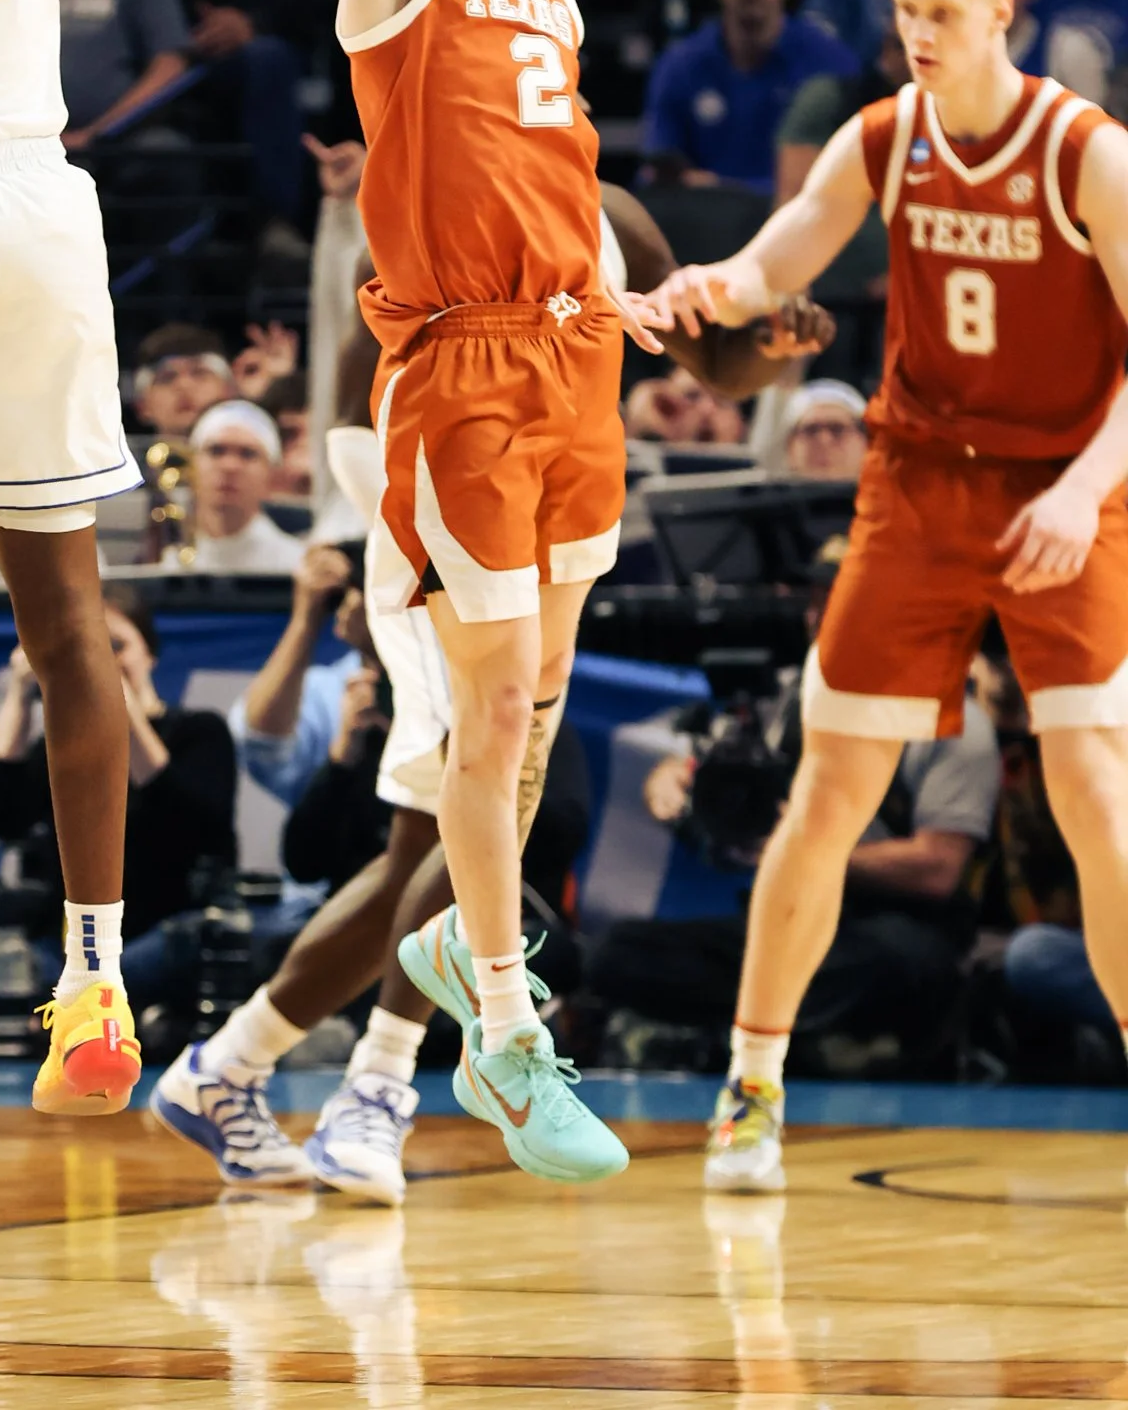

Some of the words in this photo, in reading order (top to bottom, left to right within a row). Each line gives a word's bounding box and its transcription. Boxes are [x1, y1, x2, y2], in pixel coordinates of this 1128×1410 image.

[509, 32, 574, 128] 2
[905, 202, 1043, 265] TEXAS
[945, 267, 998, 356] 8
